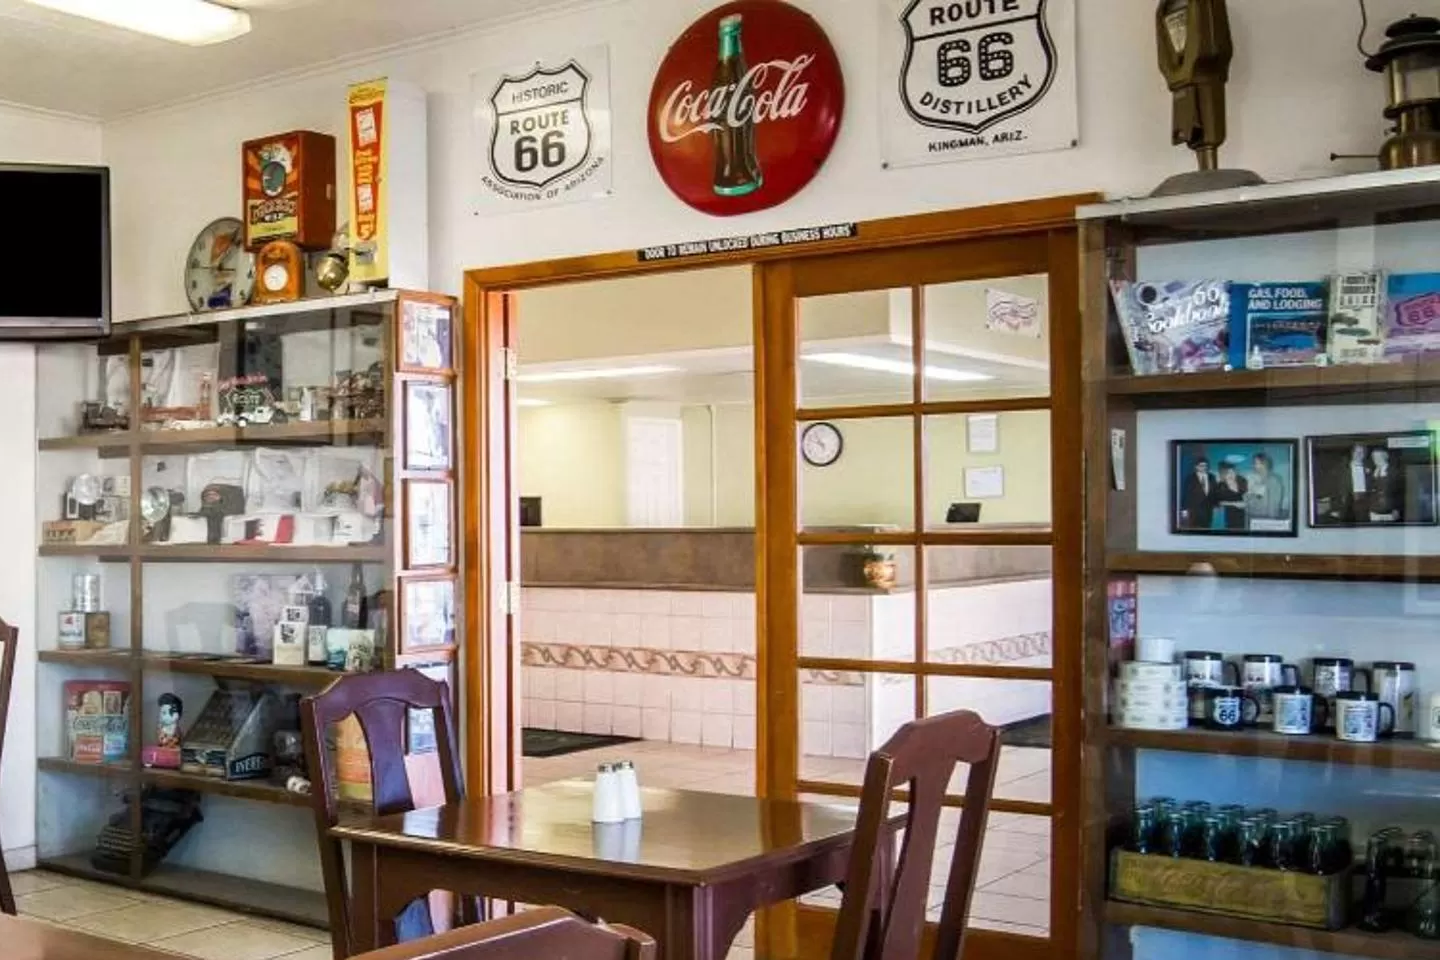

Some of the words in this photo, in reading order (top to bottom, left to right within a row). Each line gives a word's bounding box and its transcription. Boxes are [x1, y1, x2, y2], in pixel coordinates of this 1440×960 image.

[929, 0, 1019, 26] ROUTE
[937, 32, 1014, 87] 66
[512, 81, 568, 104] HISTORIC
[660, 52, 816, 143] Coca-Cola
[919, 73, 1032, 115] DISTILLERY
[510, 109, 569, 135] ROUTE
[992, 130, 1028, 145] ARIZ.
[514, 130, 566, 172] 66
[481, 176, 541, 201] ASSOCIATION
[546, 188, 560, 199] OF
[564, 157, 604, 191] ARIZONA
[1248, 299, 1271, 310] AND
[1272, 298, 1323, 310] LODGING
[1219, 709, 1238, 722] 66
